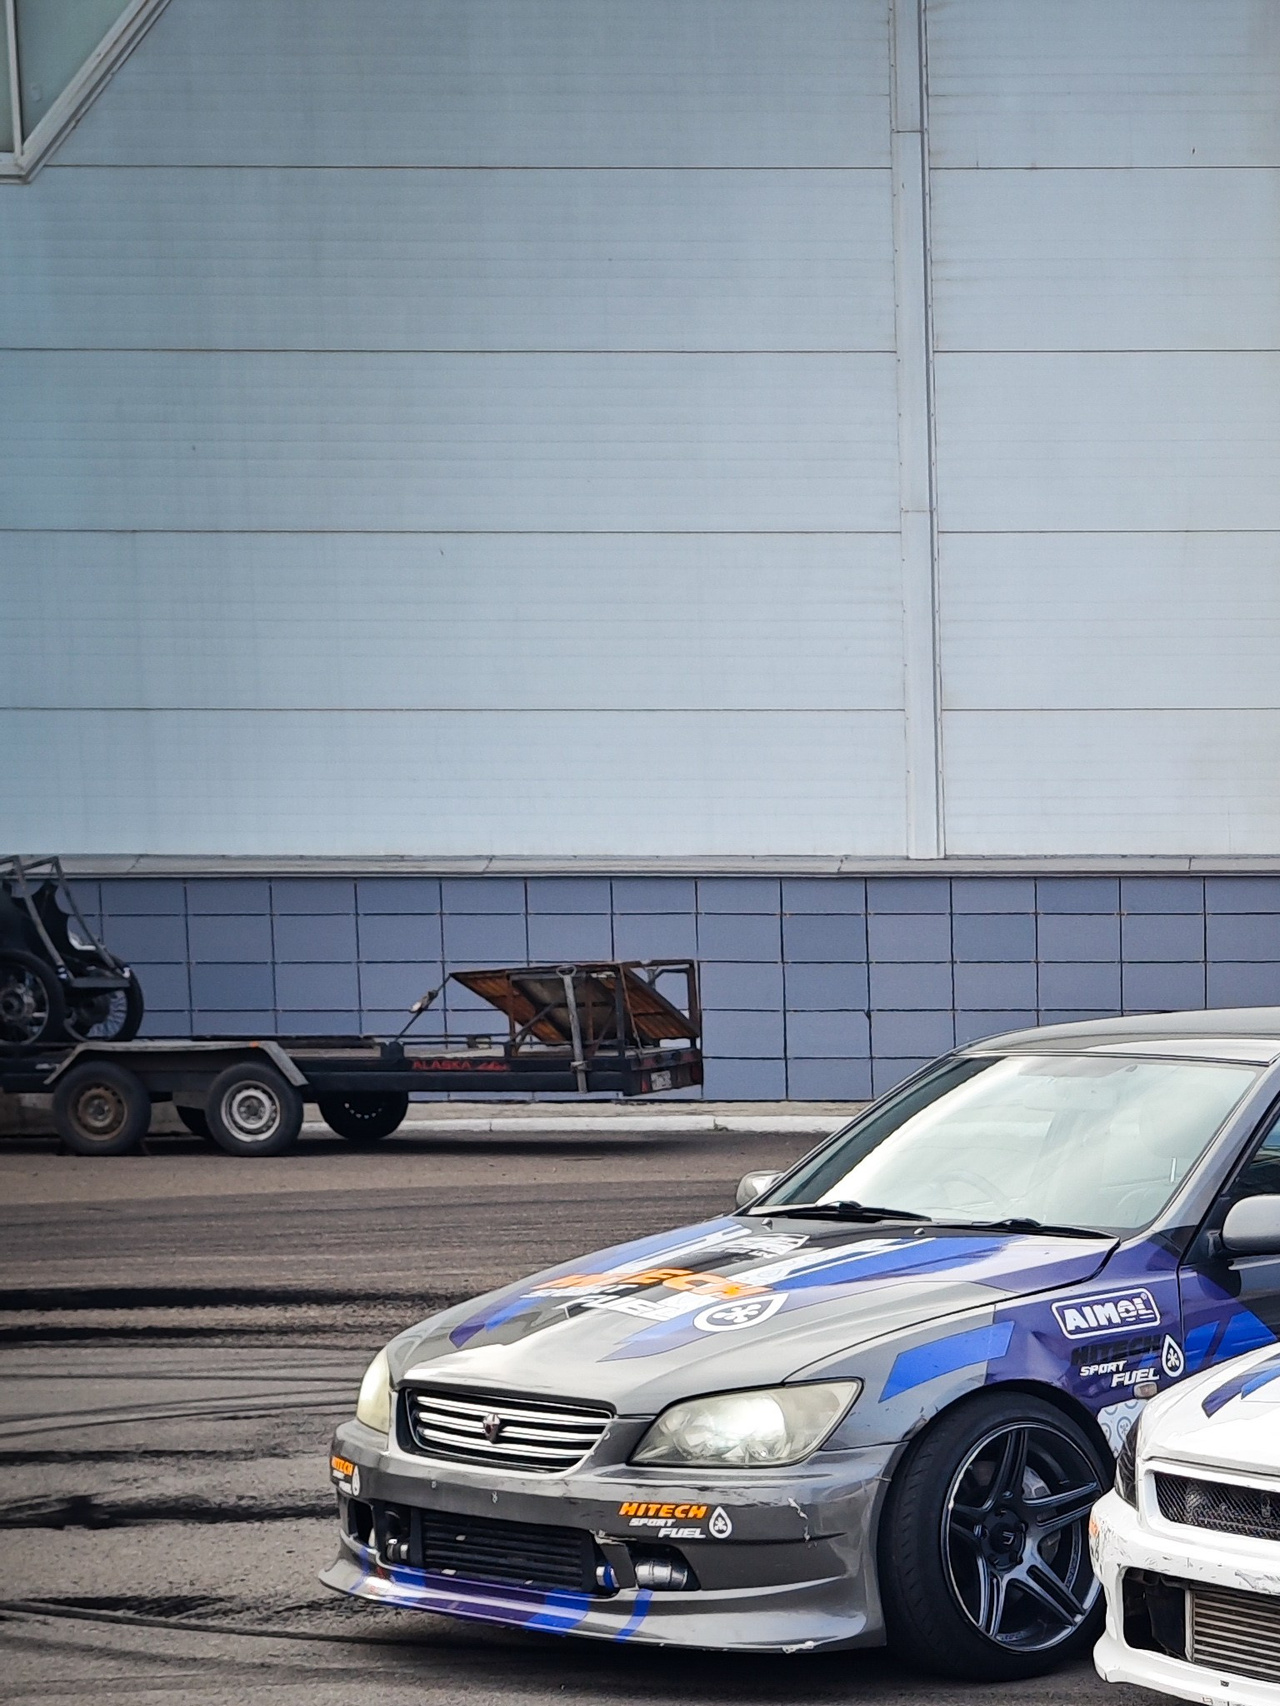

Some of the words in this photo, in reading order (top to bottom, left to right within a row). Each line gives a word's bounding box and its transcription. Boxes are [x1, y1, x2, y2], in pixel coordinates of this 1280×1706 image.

[413, 1060, 471, 1071] ALASKA
[1063, 1297, 1154, 1331] AIMOL
[1071, 1334, 1161, 1366] HITECH
[1080, 1360, 1127, 1377] SPORT
[1110, 1367, 1160, 1388] FUEL
[618, 1502, 708, 1519] HITECH
[629, 1518, 677, 1527] SPORT
[658, 1527, 707, 1539] FUEL
